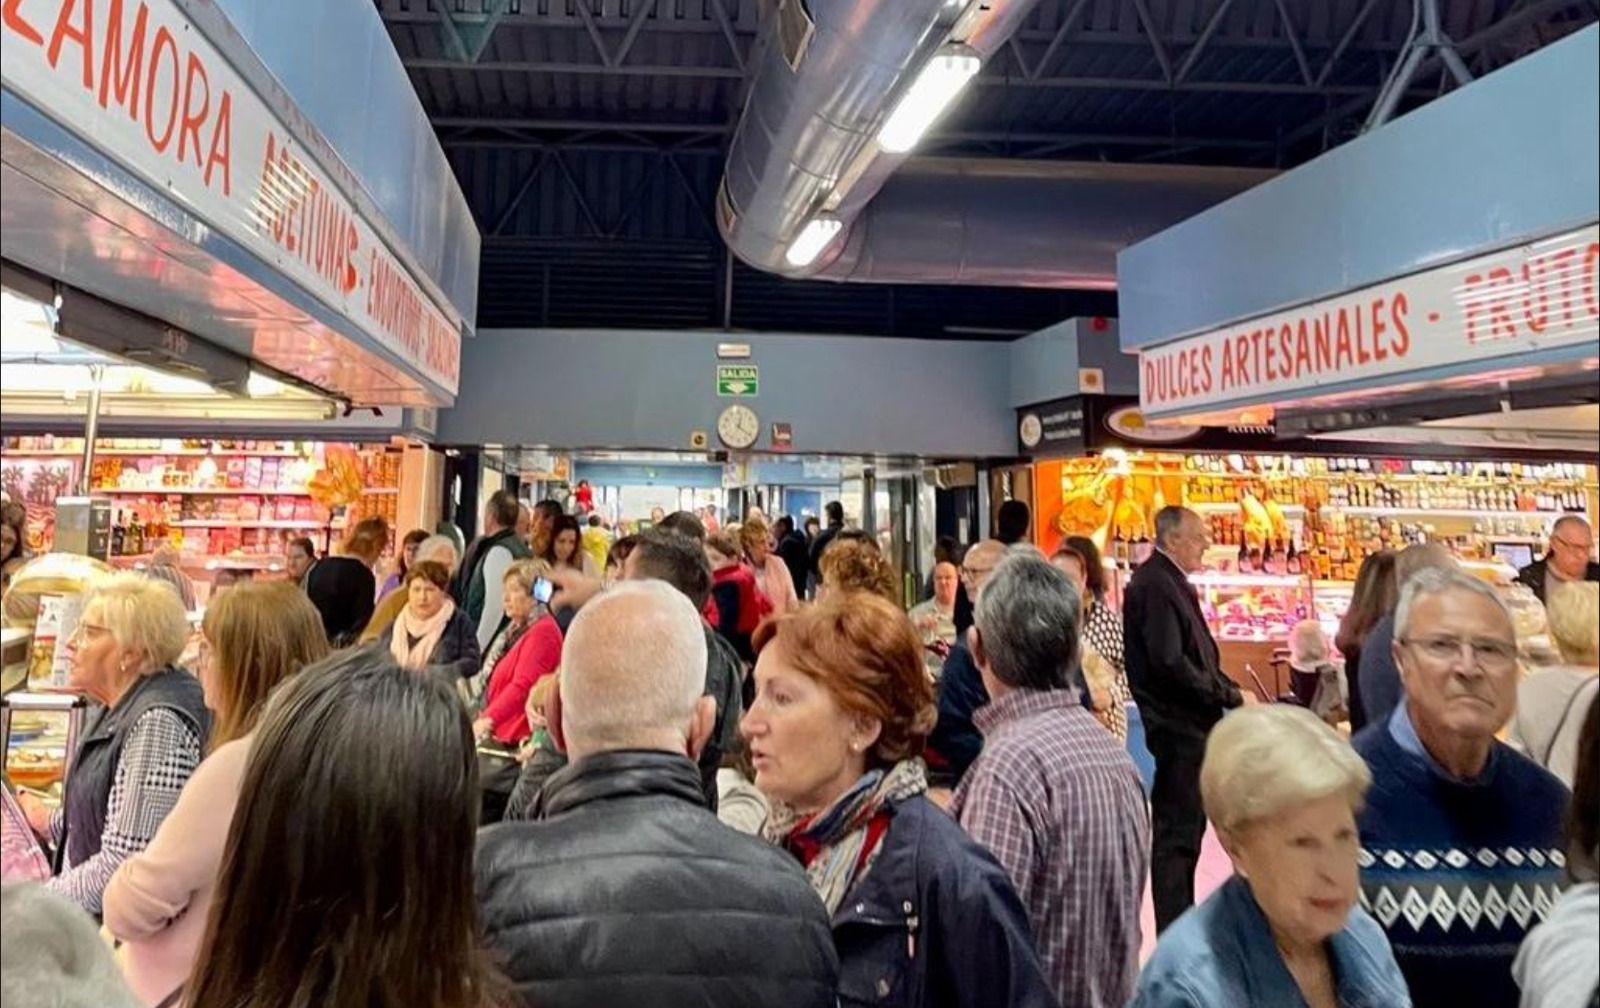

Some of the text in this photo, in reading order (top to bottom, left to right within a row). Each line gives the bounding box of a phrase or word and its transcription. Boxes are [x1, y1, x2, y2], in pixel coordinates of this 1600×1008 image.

[720, 368, 757, 379] SALIDA
[1146, 344, 1212, 404] DULCES
[1220, 292, 1409, 392] ARTESANALES
